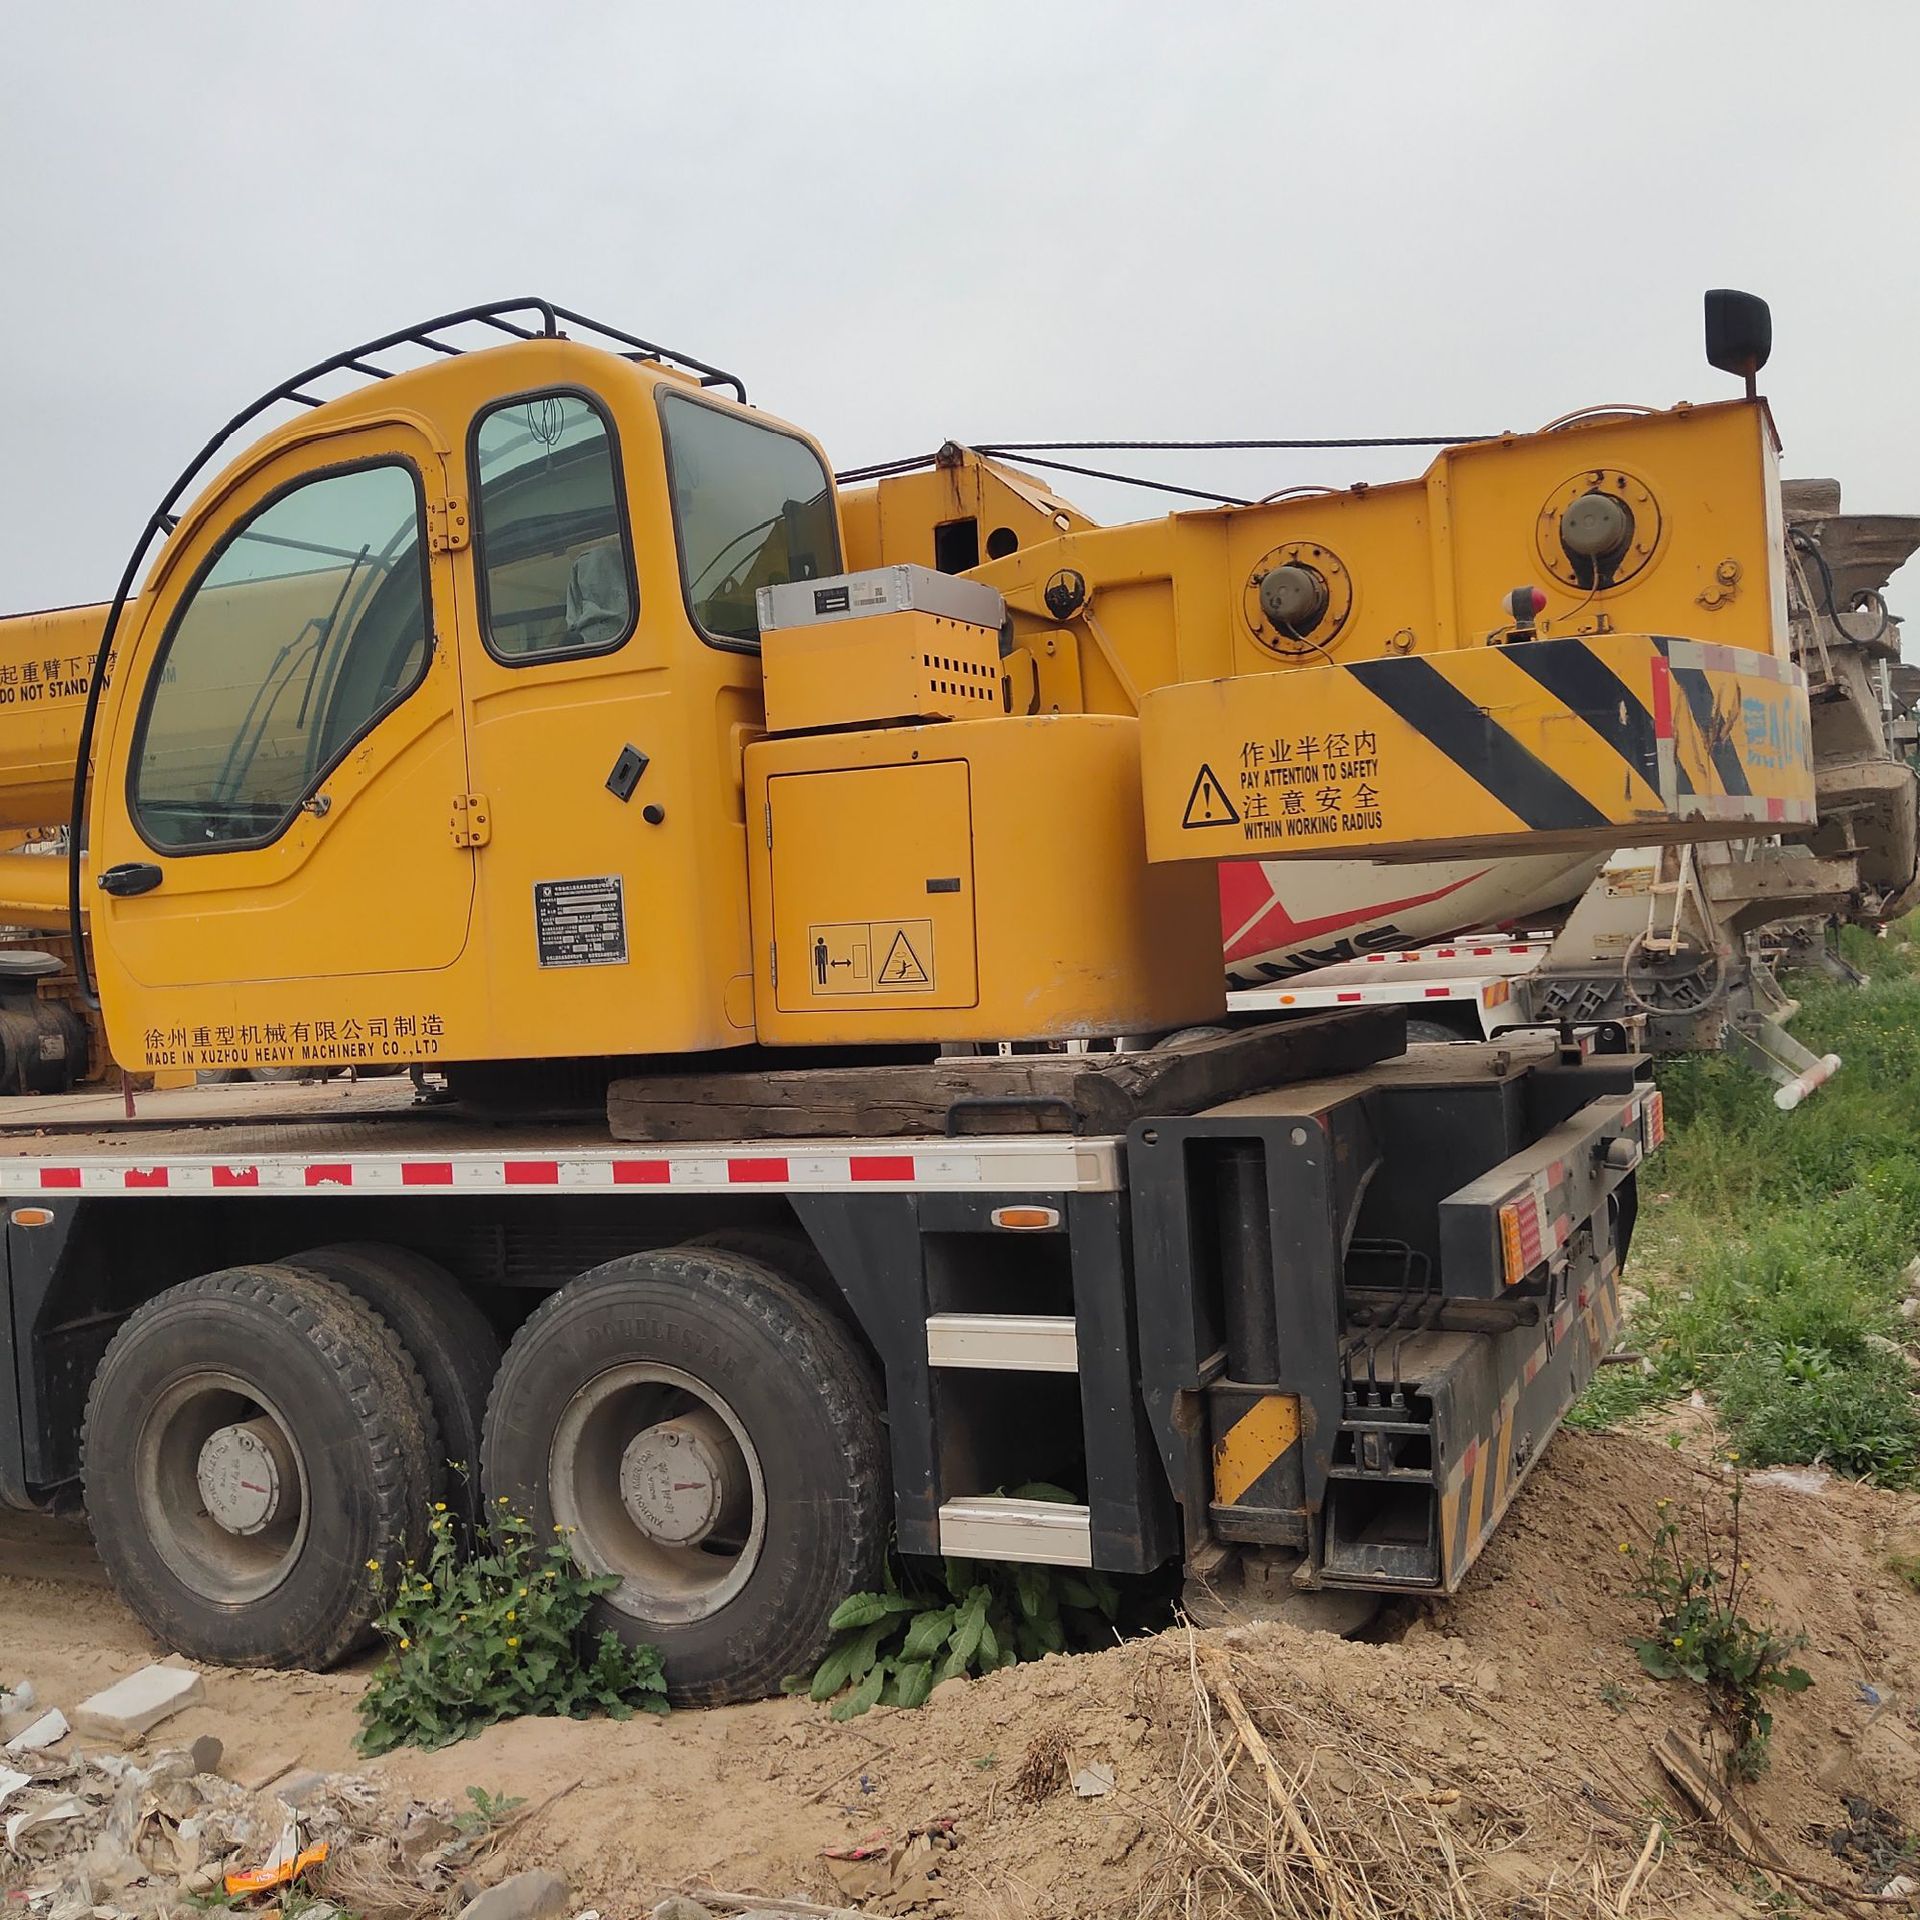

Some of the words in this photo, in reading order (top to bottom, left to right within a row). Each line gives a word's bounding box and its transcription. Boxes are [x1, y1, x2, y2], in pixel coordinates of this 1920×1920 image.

[0, 687, 15, 703] DO
[20, 684, 44, 701] NOT
[50, 678, 88, 699] STAND
[1239, 729, 1377, 768] 作业半径内
[1241, 771, 1260, 789] PAY
[1264, 765, 1319, 787] ATTENTION
[1322, 763, 1336, 781] TO
[1340, 759, 1379, 780] SAFETY
[1242, 782, 1380, 819] 注意安全
[1243, 820, 1283, 840] WITHIN
[1286, 815, 1338, 837] WORKING
[1342, 811, 1382, 831] RADIUS
[144, 1013, 445, 1050] 徐州重型机械有限公司制造
[146, 1052, 177, 1066] MADE
[183, 1051, 194, 1065] IN
[201, 1048, 249, 1064] XUZHOU
[255, 1046, 295, 1062] HEAVY
[302, 1042, 375, 1059] MACHINERY
